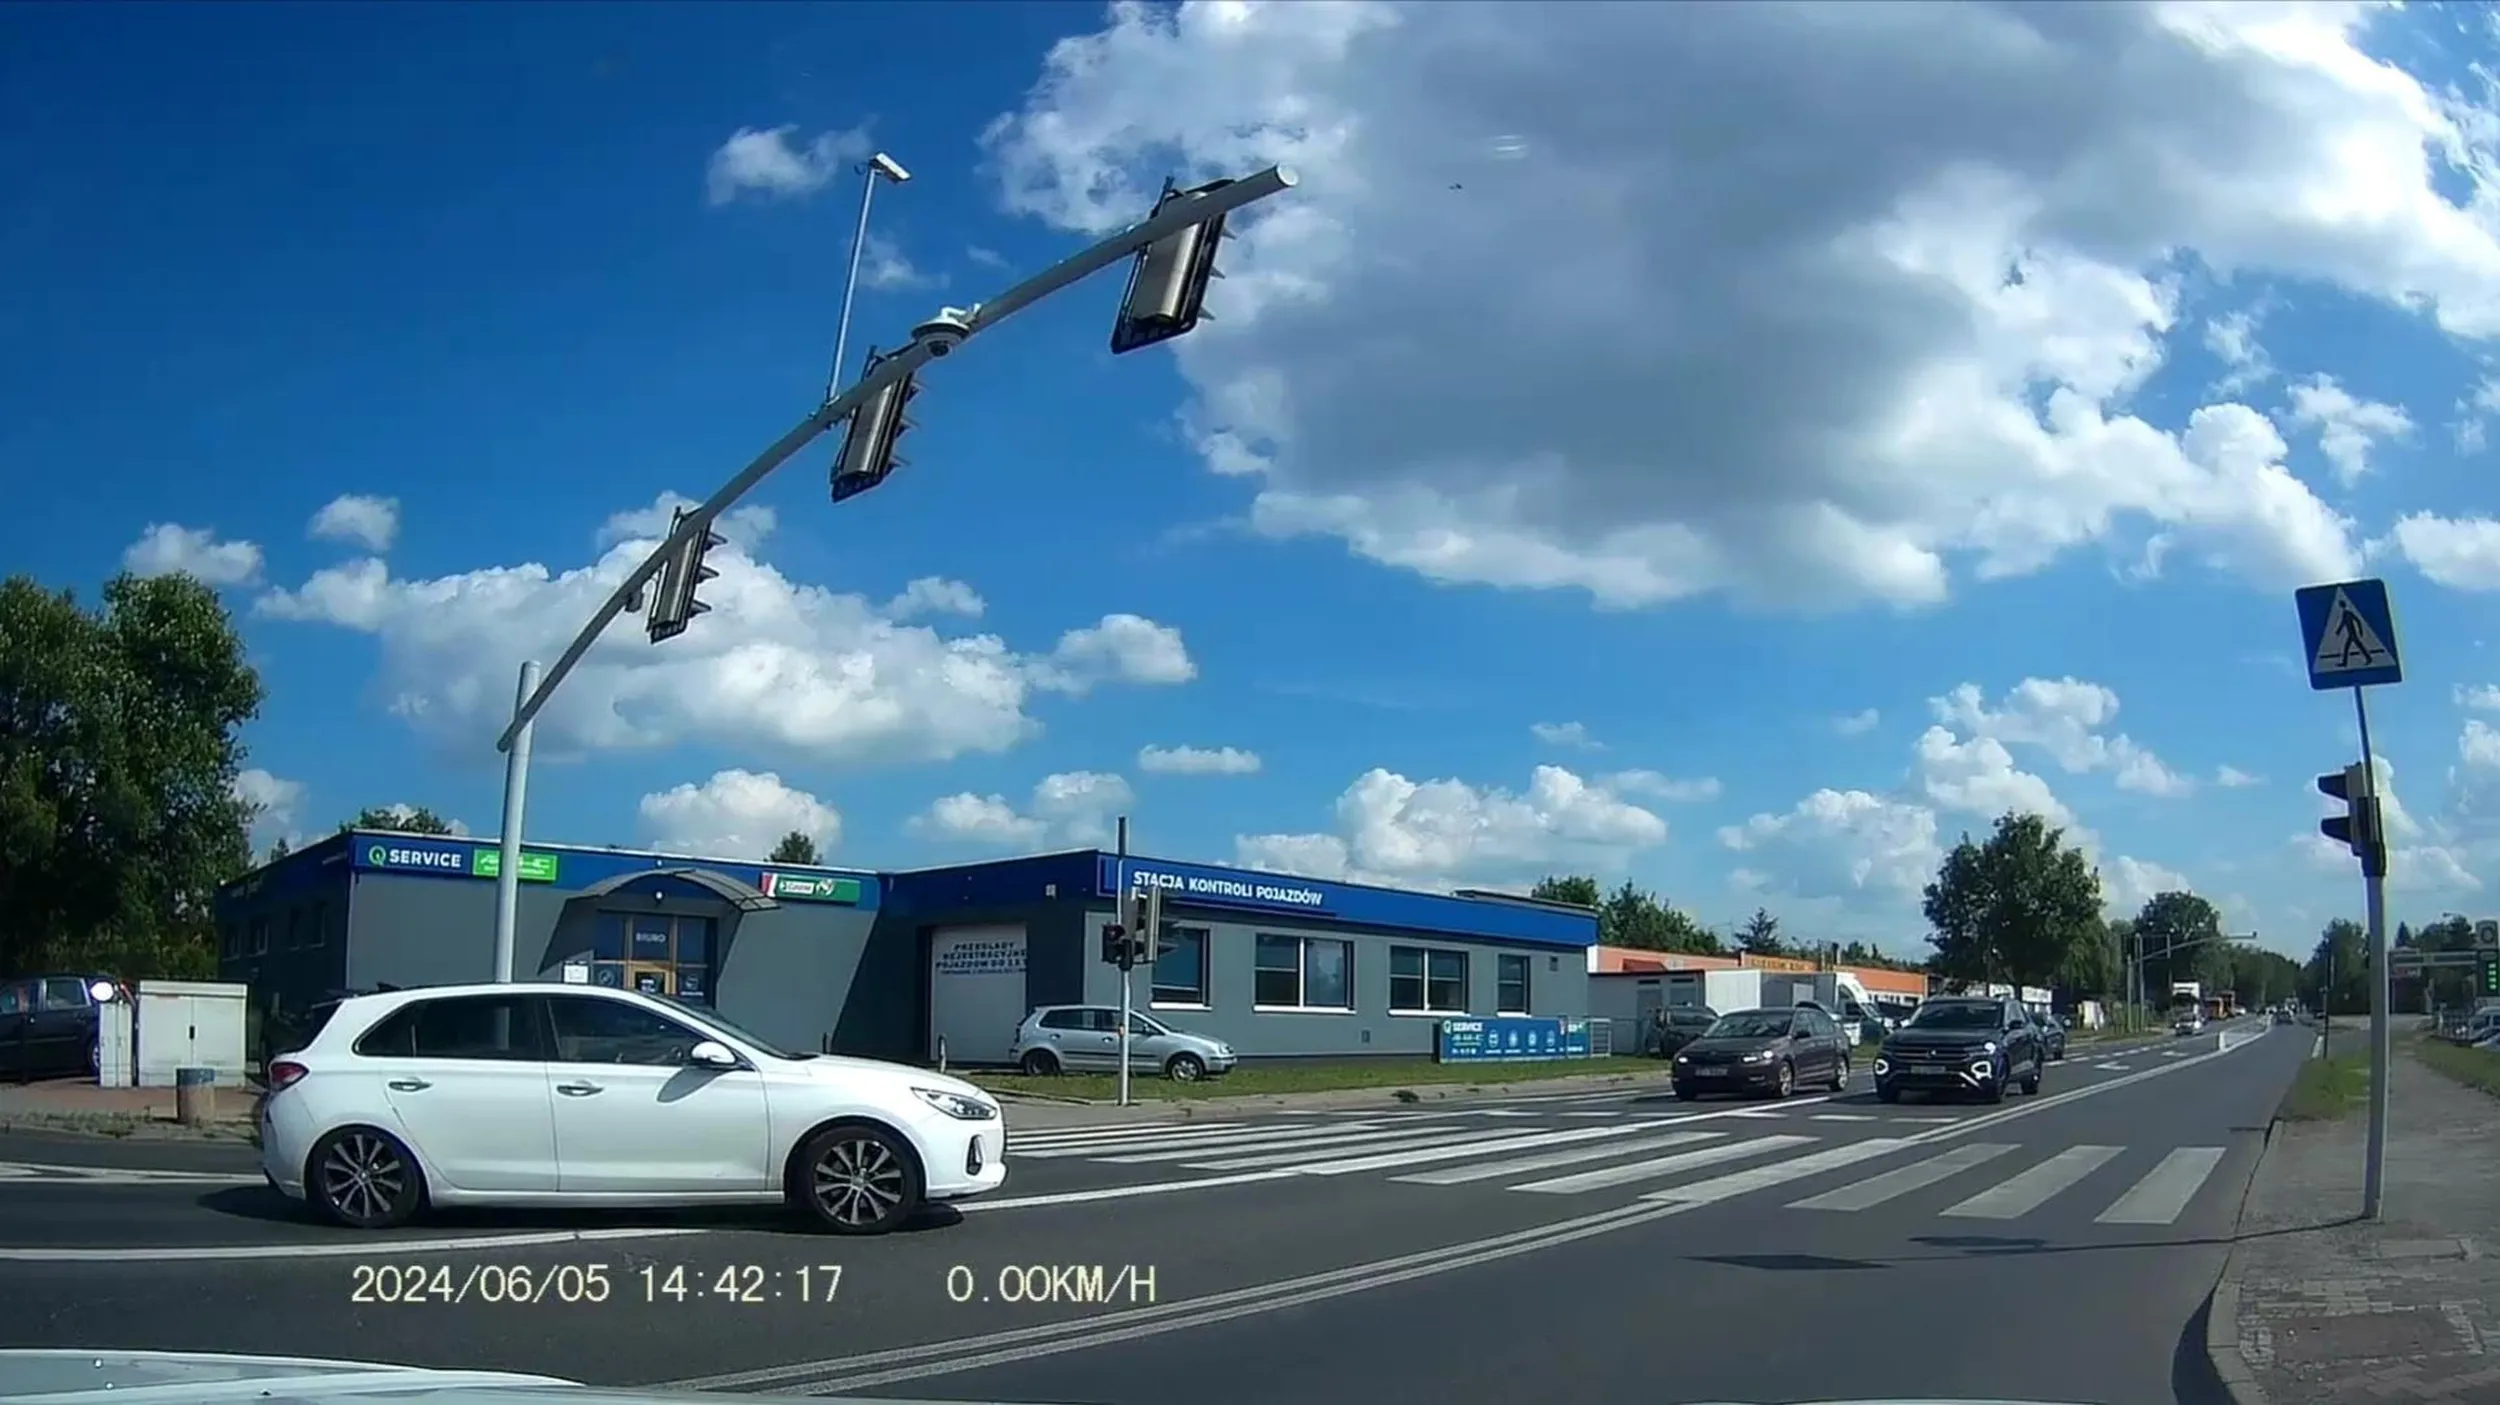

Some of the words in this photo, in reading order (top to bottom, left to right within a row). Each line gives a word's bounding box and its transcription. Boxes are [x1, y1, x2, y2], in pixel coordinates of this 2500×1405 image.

[388, 848, 463, 868] SERVICE
[1132, 870, 1185, 890] STACJA
[1188, 877, 1253, 898] KONTROLI
[1256, 886, 1323, 906] POJAZDÓW
